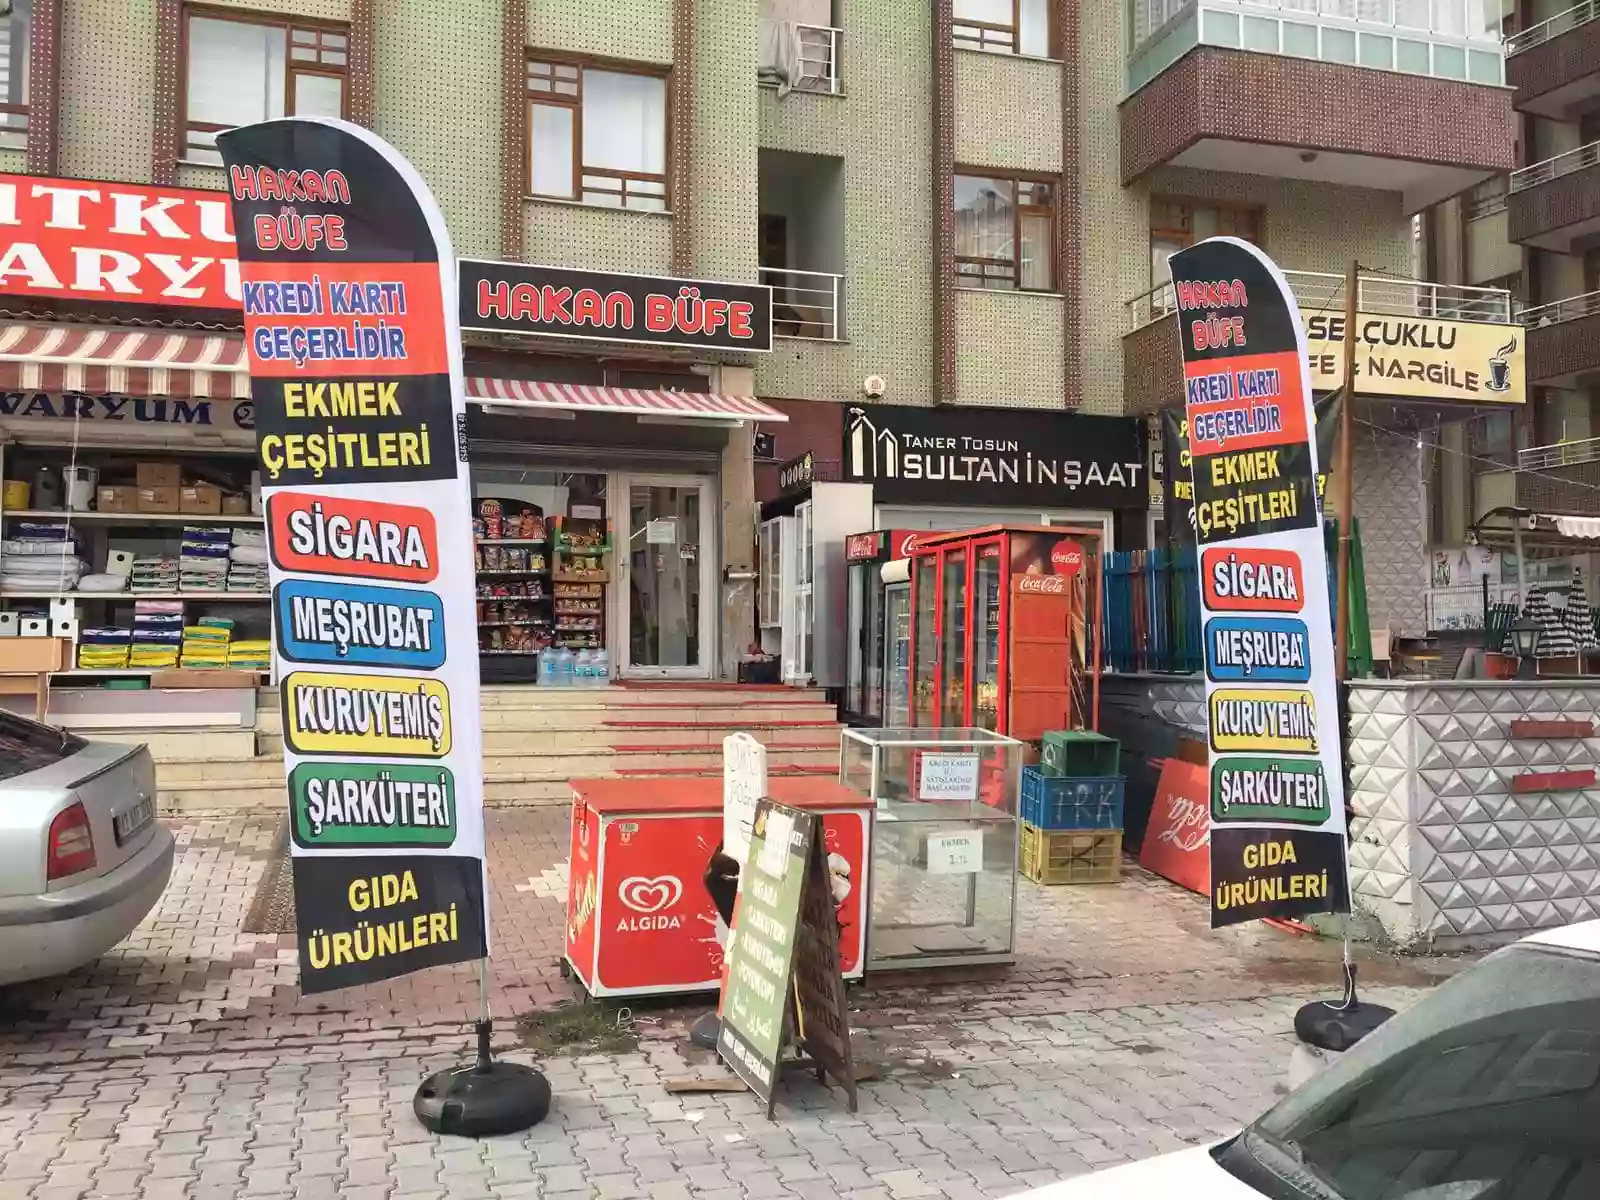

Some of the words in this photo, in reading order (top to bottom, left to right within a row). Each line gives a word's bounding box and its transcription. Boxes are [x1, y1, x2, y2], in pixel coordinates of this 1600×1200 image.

[231, 164, 351, 204] HAKAN
[254, 206, 348, 251] BÜFE
[243, 276, 324, 315] KREDİ
[329, 281, 407, 315] KARTI
[477, 278, 634, 330] HAKAN
[645, 287, 753, 338] BÜFE
[1177, 278, 1247, 309] HAKAN
[254, 320, 407, 368] GEÇERLİDİR
[1192, 313, 1246, 350] BÜFE
[1308, 316, 1457, 352] SEÇUKLU
[1187, 366, 1233, 403] KREDİ
[1237, 366, 1281, 398] KARTI
[1368, 357, 1480, 392] NARGİLE
[283, 382, 402, 417] EKMEK
[902, 433, 956, 449] TANER
[961, 436, 1018, 452] TOSUN
[1194, 400, 1282, 446] GEÇERLİDİR
[261, 423, 430, 479] ÇEŞİTLERİ
[1211, 451, 1280, 487] EKMEK
[1198, 482, 1297, 539] ÇEŞİTLERİ
[288, 501, 428, 569] SİGARA
[1213, 552, 1298, 601] SİGARA
[289, 596, 434, 657] MEŞRUBAT
[1215, 630, 1305, 676] MEŞRUBAT
[294, 683, 445, 751] KURUYEMİŞ
[1216, 694, 1318, 750] KURUYEMİŞ
[305, 771, 450, 838] ŞARKÜTERİ
[1220, 762, 1324, 813] ŞARKÜTERİ
[1243, 840, 1297, 868] GIDA
[348, 870, 418, 912] GIDA
[1216, 868, 1327, 910] ÜRÜNLERİ
[308, 903, 458, 969] ÜRÜNLERİ
